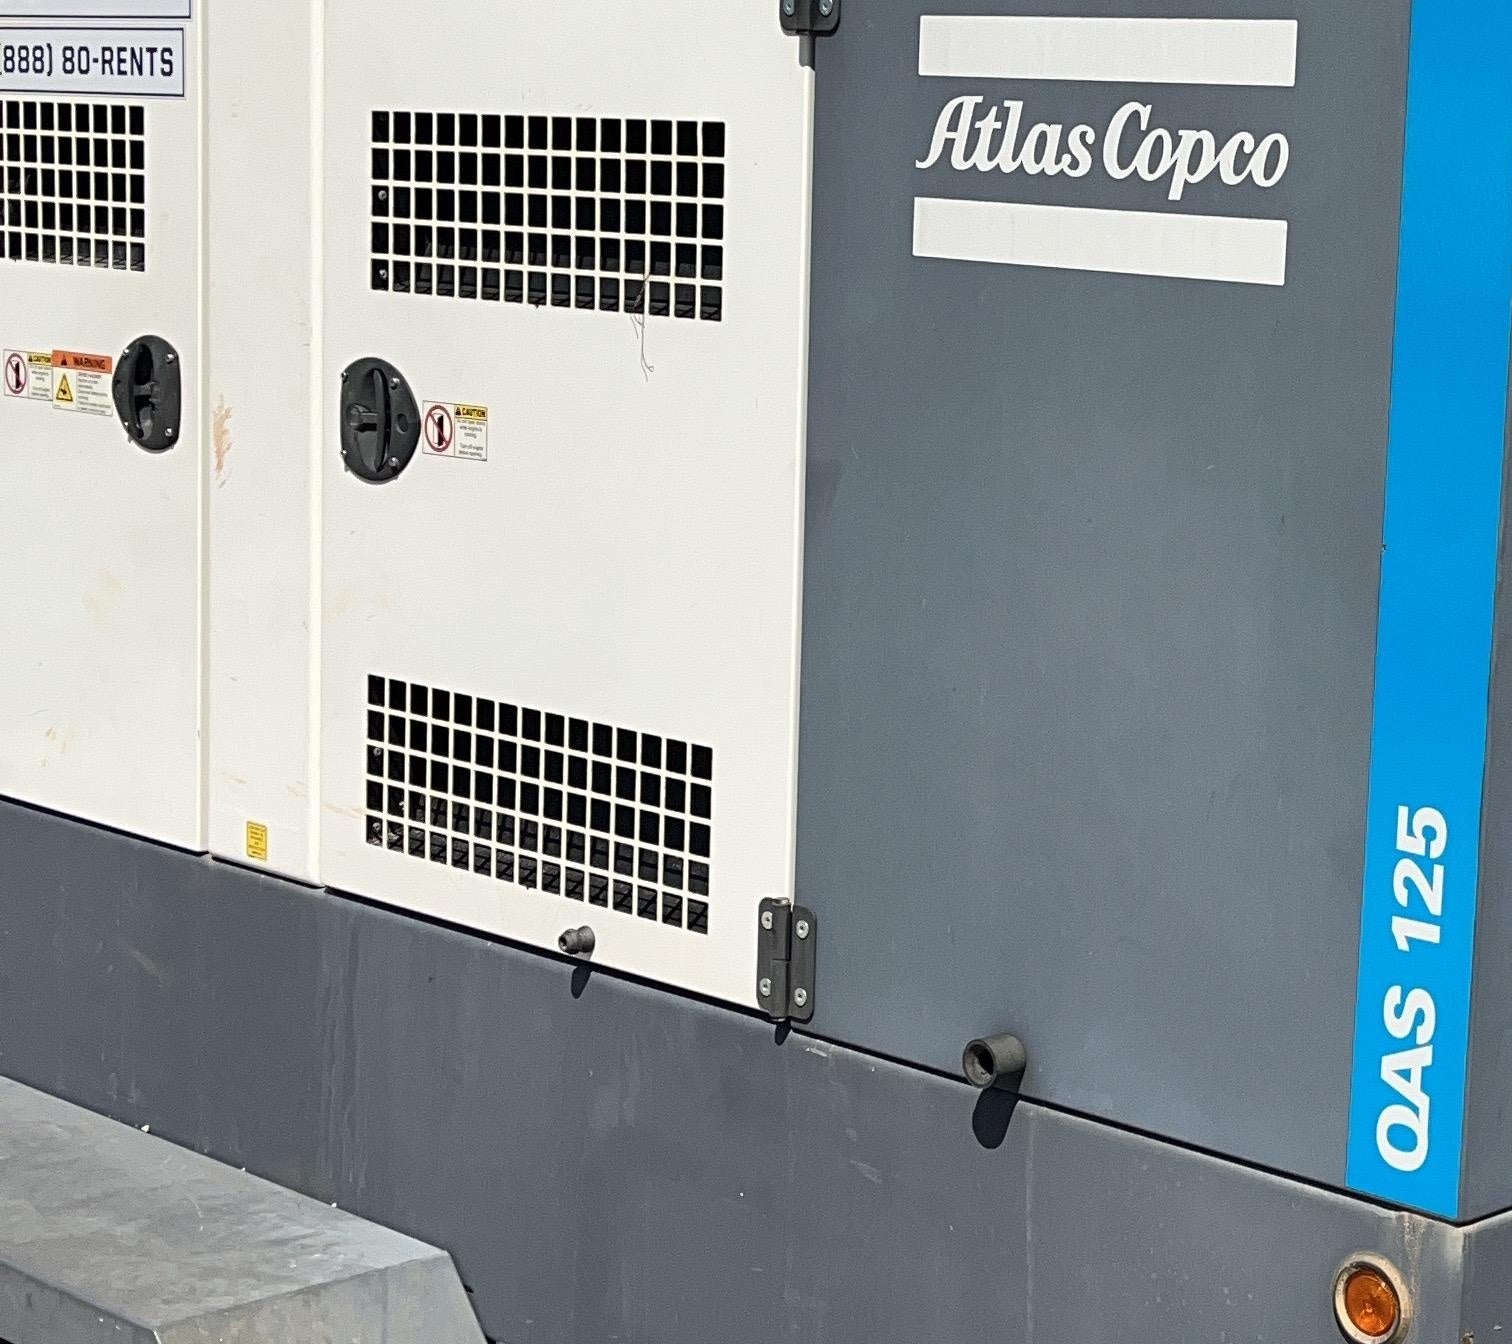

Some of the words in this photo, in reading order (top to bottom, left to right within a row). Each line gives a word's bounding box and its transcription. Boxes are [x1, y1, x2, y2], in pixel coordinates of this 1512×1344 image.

[0, 43, 53, 77] 888)
[62, 45, 174, 77] 80-RENTS
[915, 95, 1097, 178] Atlas
[1102, 101, 1290, 201] Copco
[73, 357, 106, 370] WARNING
[462, 407, 486, 418] CAUTION
[1391, 805, 1449, 953] 125
[1375, 984, 1438, 1172] QAS
